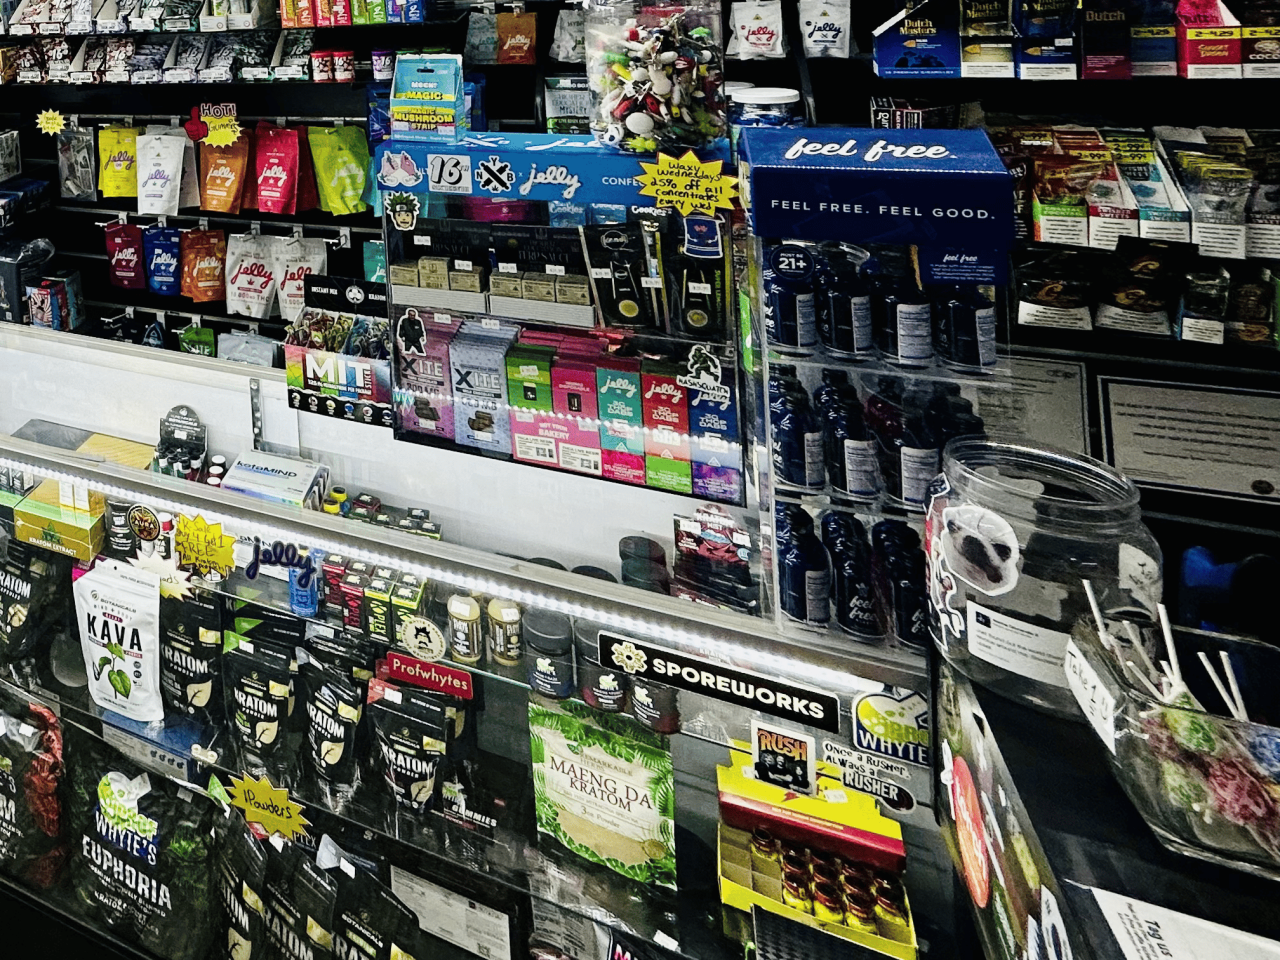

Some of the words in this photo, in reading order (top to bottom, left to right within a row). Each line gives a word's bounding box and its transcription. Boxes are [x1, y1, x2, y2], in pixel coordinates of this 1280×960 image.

[904, 18, 933, 30] Dutch
[1085, 9, 1125, 22] Dutch
[899, 25, 937, 36] Masters
[406, 92, 443, 100] MAGIC
[200, 103, 237, 119] HOT!
[394, 113, 453, 123] MUSHROOM
[785, 138, 857, 160] feel
[104, 151, 135, 170] jelly
[142, 169, 170, 188] jelly
[206, 165, 235, 187] jelly
[258, 163, 288, 187] jelly
[520, 163, 581, 199] jelly
[684, 180, 701, 190] off
[659, 199, 684, 209] every
[771, 200, 811, 211] FEEL
[819, 202, 870, 214] FREE.
[879, 205, 922, 216] FEEL
[932, 208, 995, 219] GOOD.
[111, 247, 138, 267] jelly
[193, 257, 222, 277] jelly
[778, 257, 807, 269] 21+
[230, 261, 274, 293] jelly
[305, 353, 371, 388] MIT
[402, 356, 443, 376] XITE
[454, 368, 500, 388] XITE
[601, 376, 637, 398] jelly
[645, 381, 682, 403] jelly
[182, 542, 214, 557] FREE
[245, 537, 317, 588] jelly
[87, 612, 142, 652] KAVA
[392, 659, 469, 690] Profwhytes
[653, 658, 824, 719] SPOREWORKS
[233, 687, 278, 719] KRATOM
[757, 729, 808, 761] RUSH
[549, 756, 618, 794] MAENG
[625, 784, 653, 810] DA
[569, 776, 632, 812] KRATOM
[846, 771, 898, 800] RUSHER
[95, 810, 156, 865] WHYTE'S
[83, 835, 172, 910] EUPHORIA
